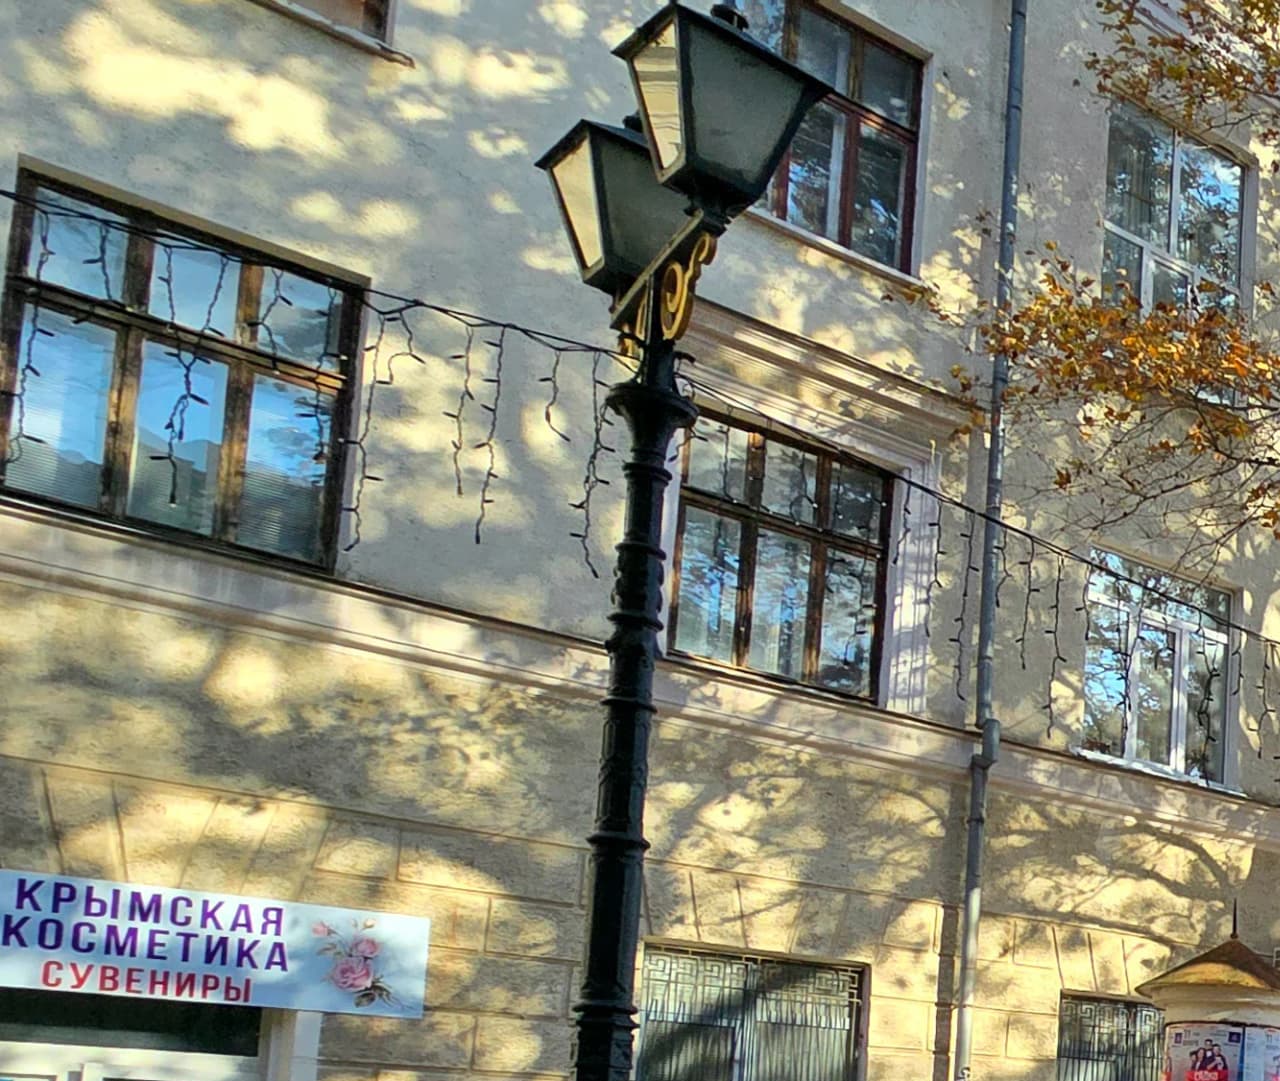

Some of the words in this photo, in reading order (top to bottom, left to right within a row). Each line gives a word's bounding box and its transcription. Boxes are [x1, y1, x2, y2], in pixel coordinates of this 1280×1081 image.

[15, 877, 284, 936] КРЫМСКАЯ
[1, 914, 289, 972] КОСМЕТИКА
[41, 959, 252, 1003] СУВЕНИРЫ
